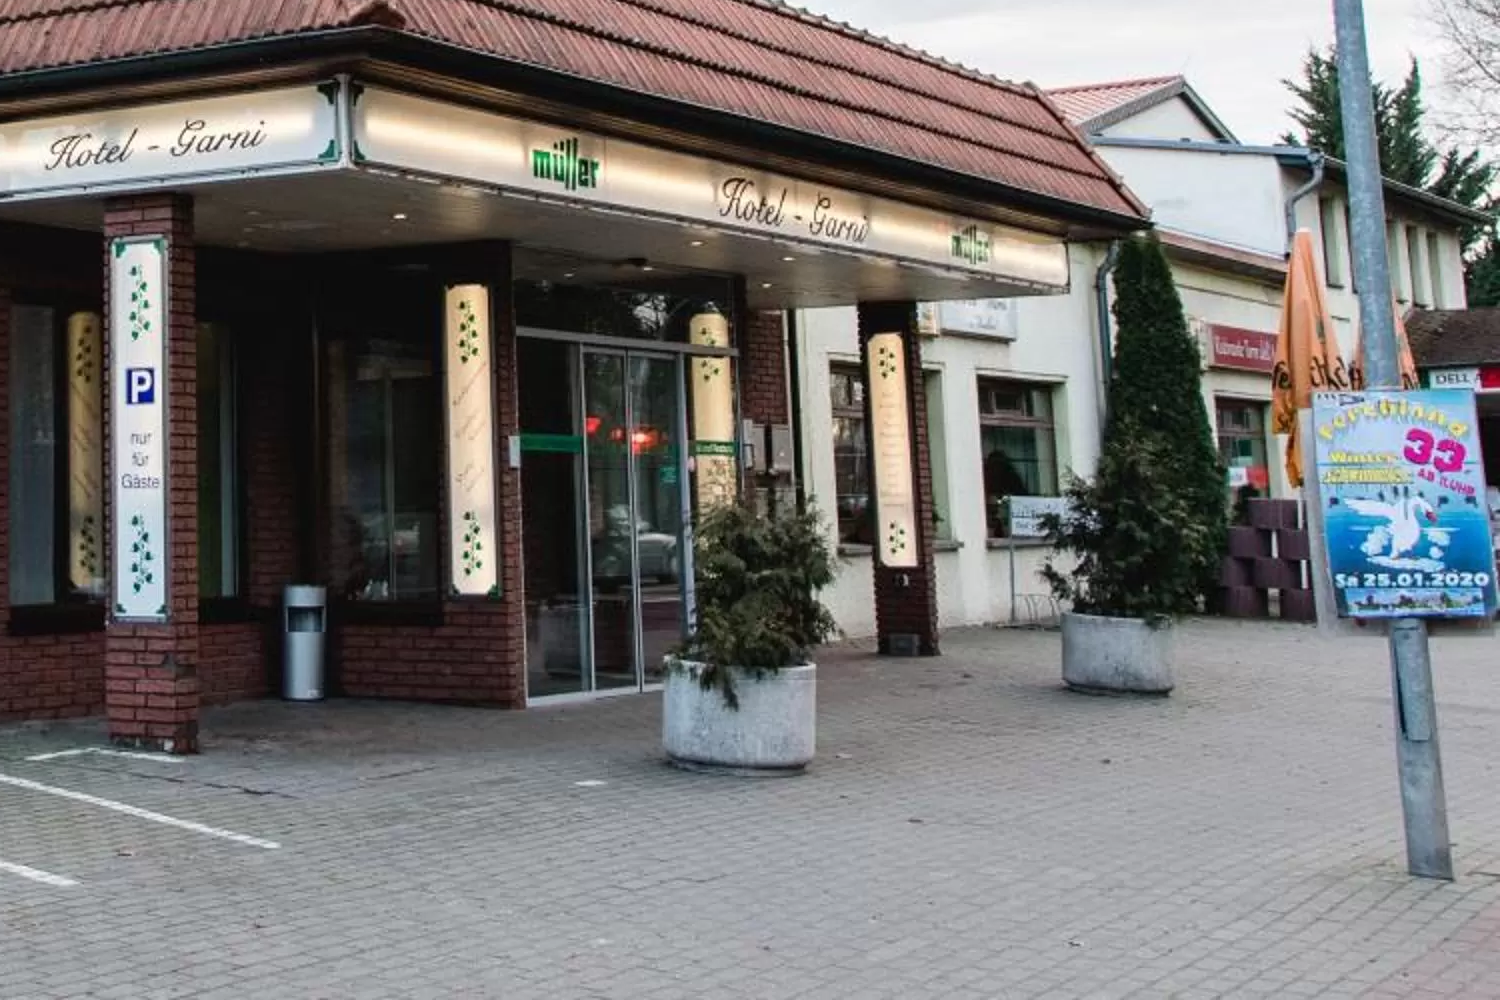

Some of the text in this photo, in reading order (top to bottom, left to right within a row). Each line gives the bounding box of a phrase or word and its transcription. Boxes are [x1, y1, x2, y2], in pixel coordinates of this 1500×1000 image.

[45, 127, 138, 170] Hotel
[171, 119, 267, 157] Garni
[532, 137, 599, 191] müller
[719, 177, 787, 227] Hotel
[809, 191, 870, 243] Garni
[131, 370, 154, 404] P
[130, 431, 153, 445] nur
[132, 452, 150, 466] für
[121, 473, 160, 489] Gäste
[1335, 572, 1489, 587] Sa 25.01.2020
